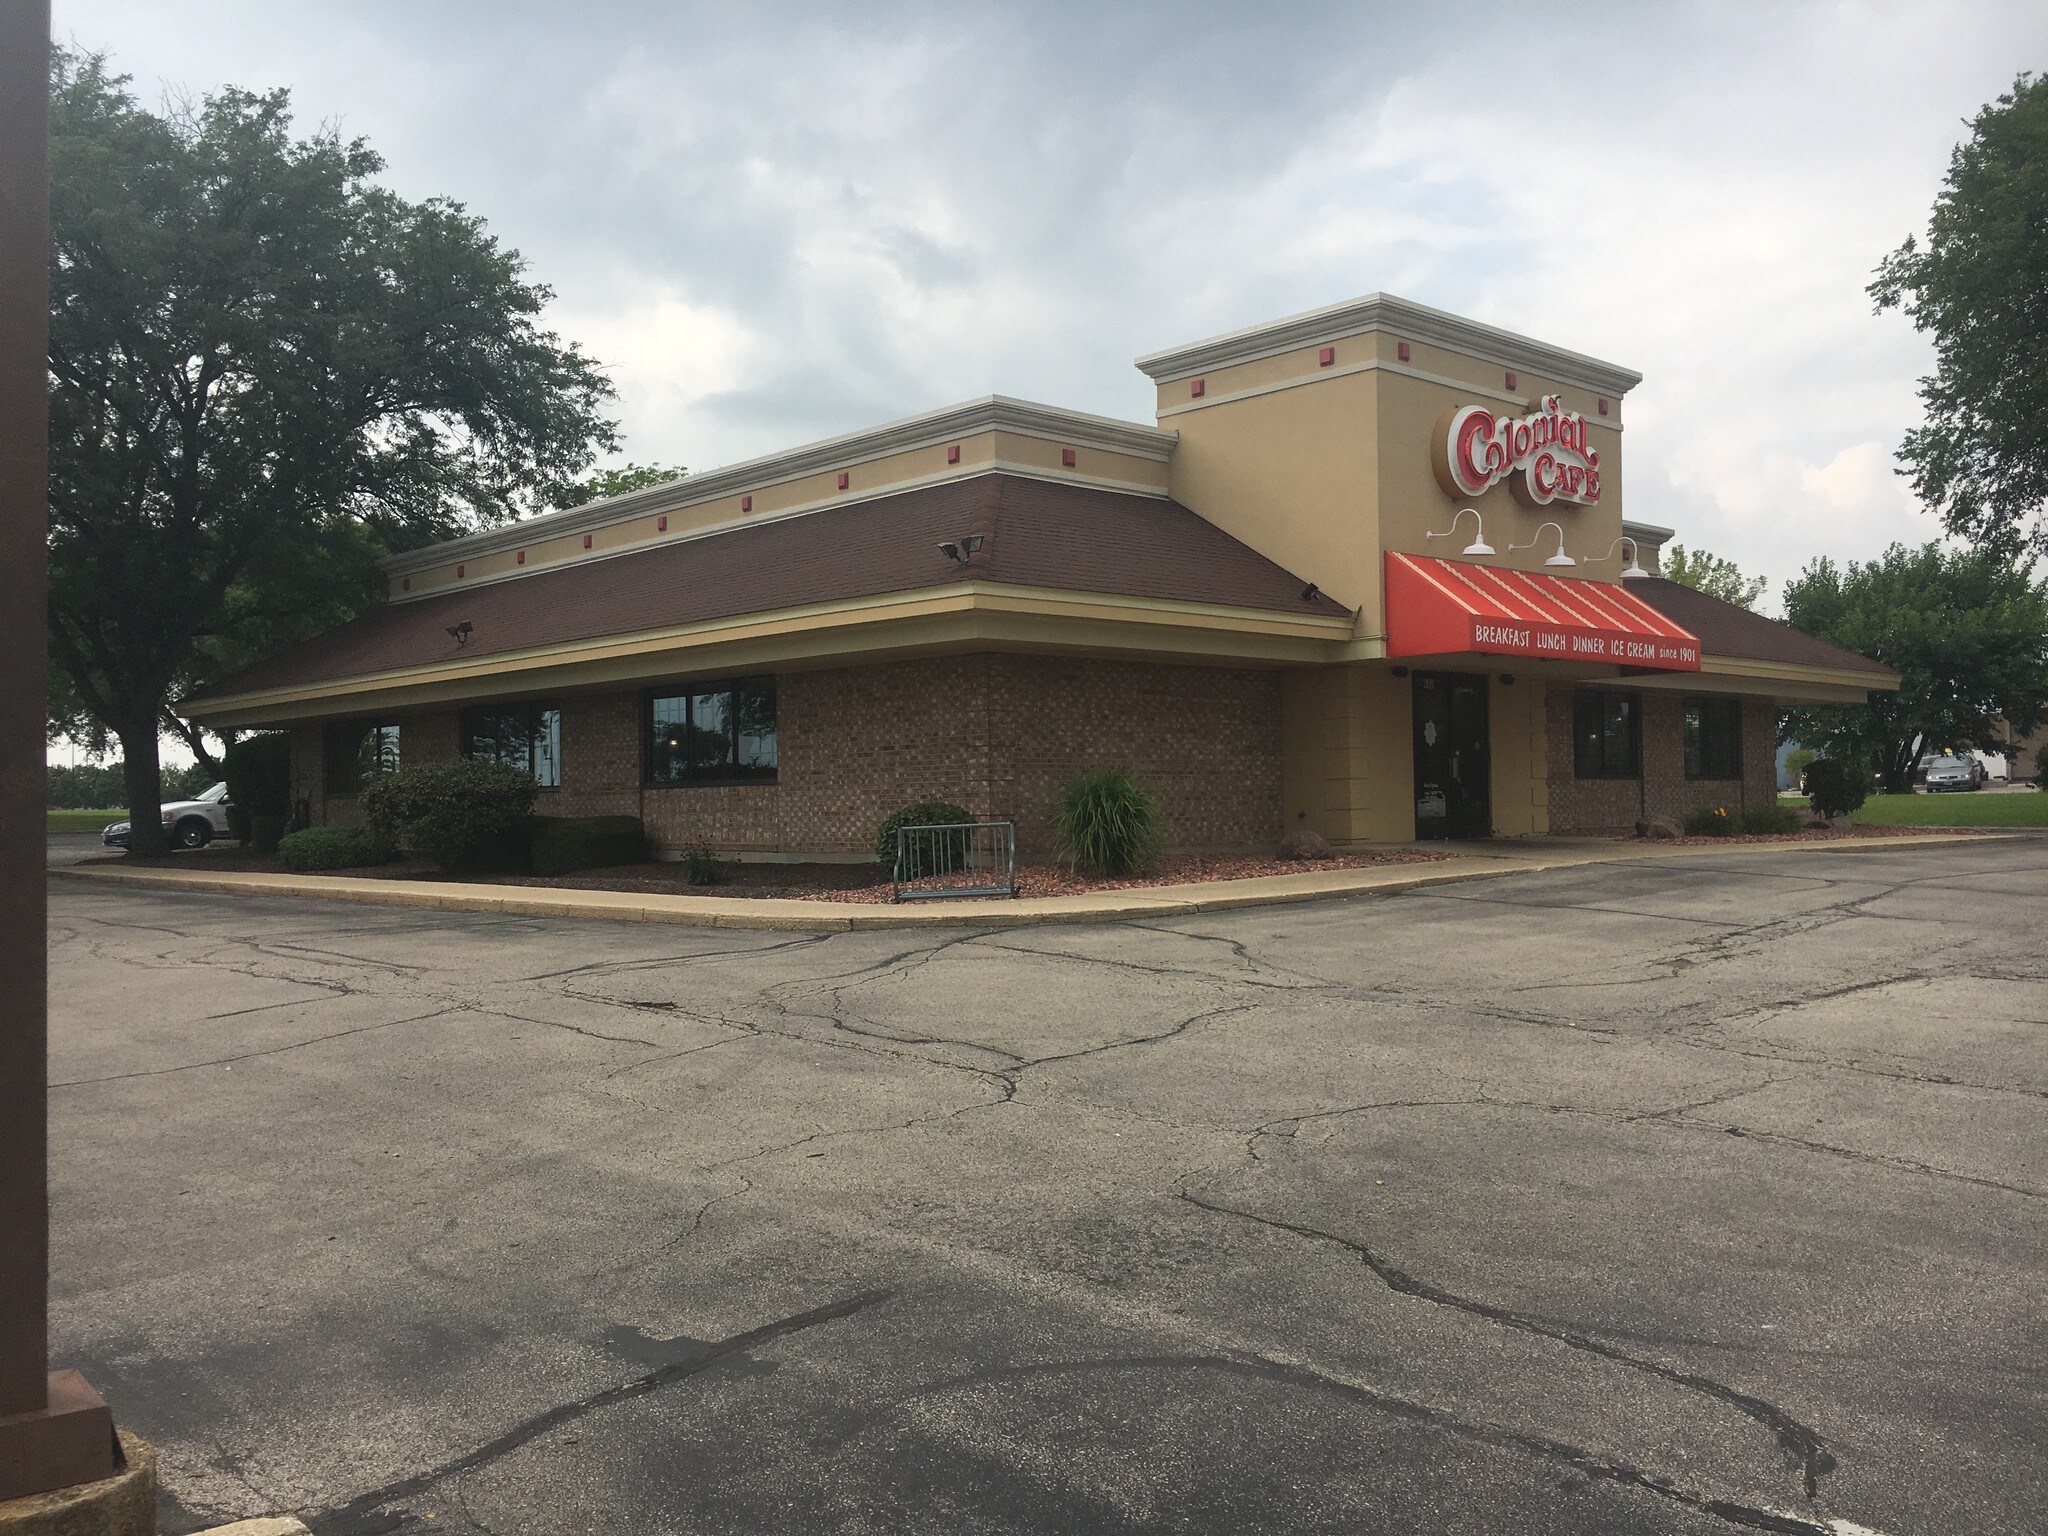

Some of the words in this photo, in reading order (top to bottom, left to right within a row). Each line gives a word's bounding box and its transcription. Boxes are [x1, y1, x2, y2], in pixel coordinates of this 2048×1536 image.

[1457, 395, 1599, 488] Colonial
[1534, 453, 1600, 501] CAFE
[1475, 625, 1530, 648] BREAKFAST
[1537, 632, 1566, 651] LUNCH
[1572, 635, 1605, 655] DINNER
[1611, 640, 1624, 656] ICE
[1627, 642, 1655, 659] CREAM
[1659, 645, 1677, 659] since
[1680, 647, 1696, 662] 1901
